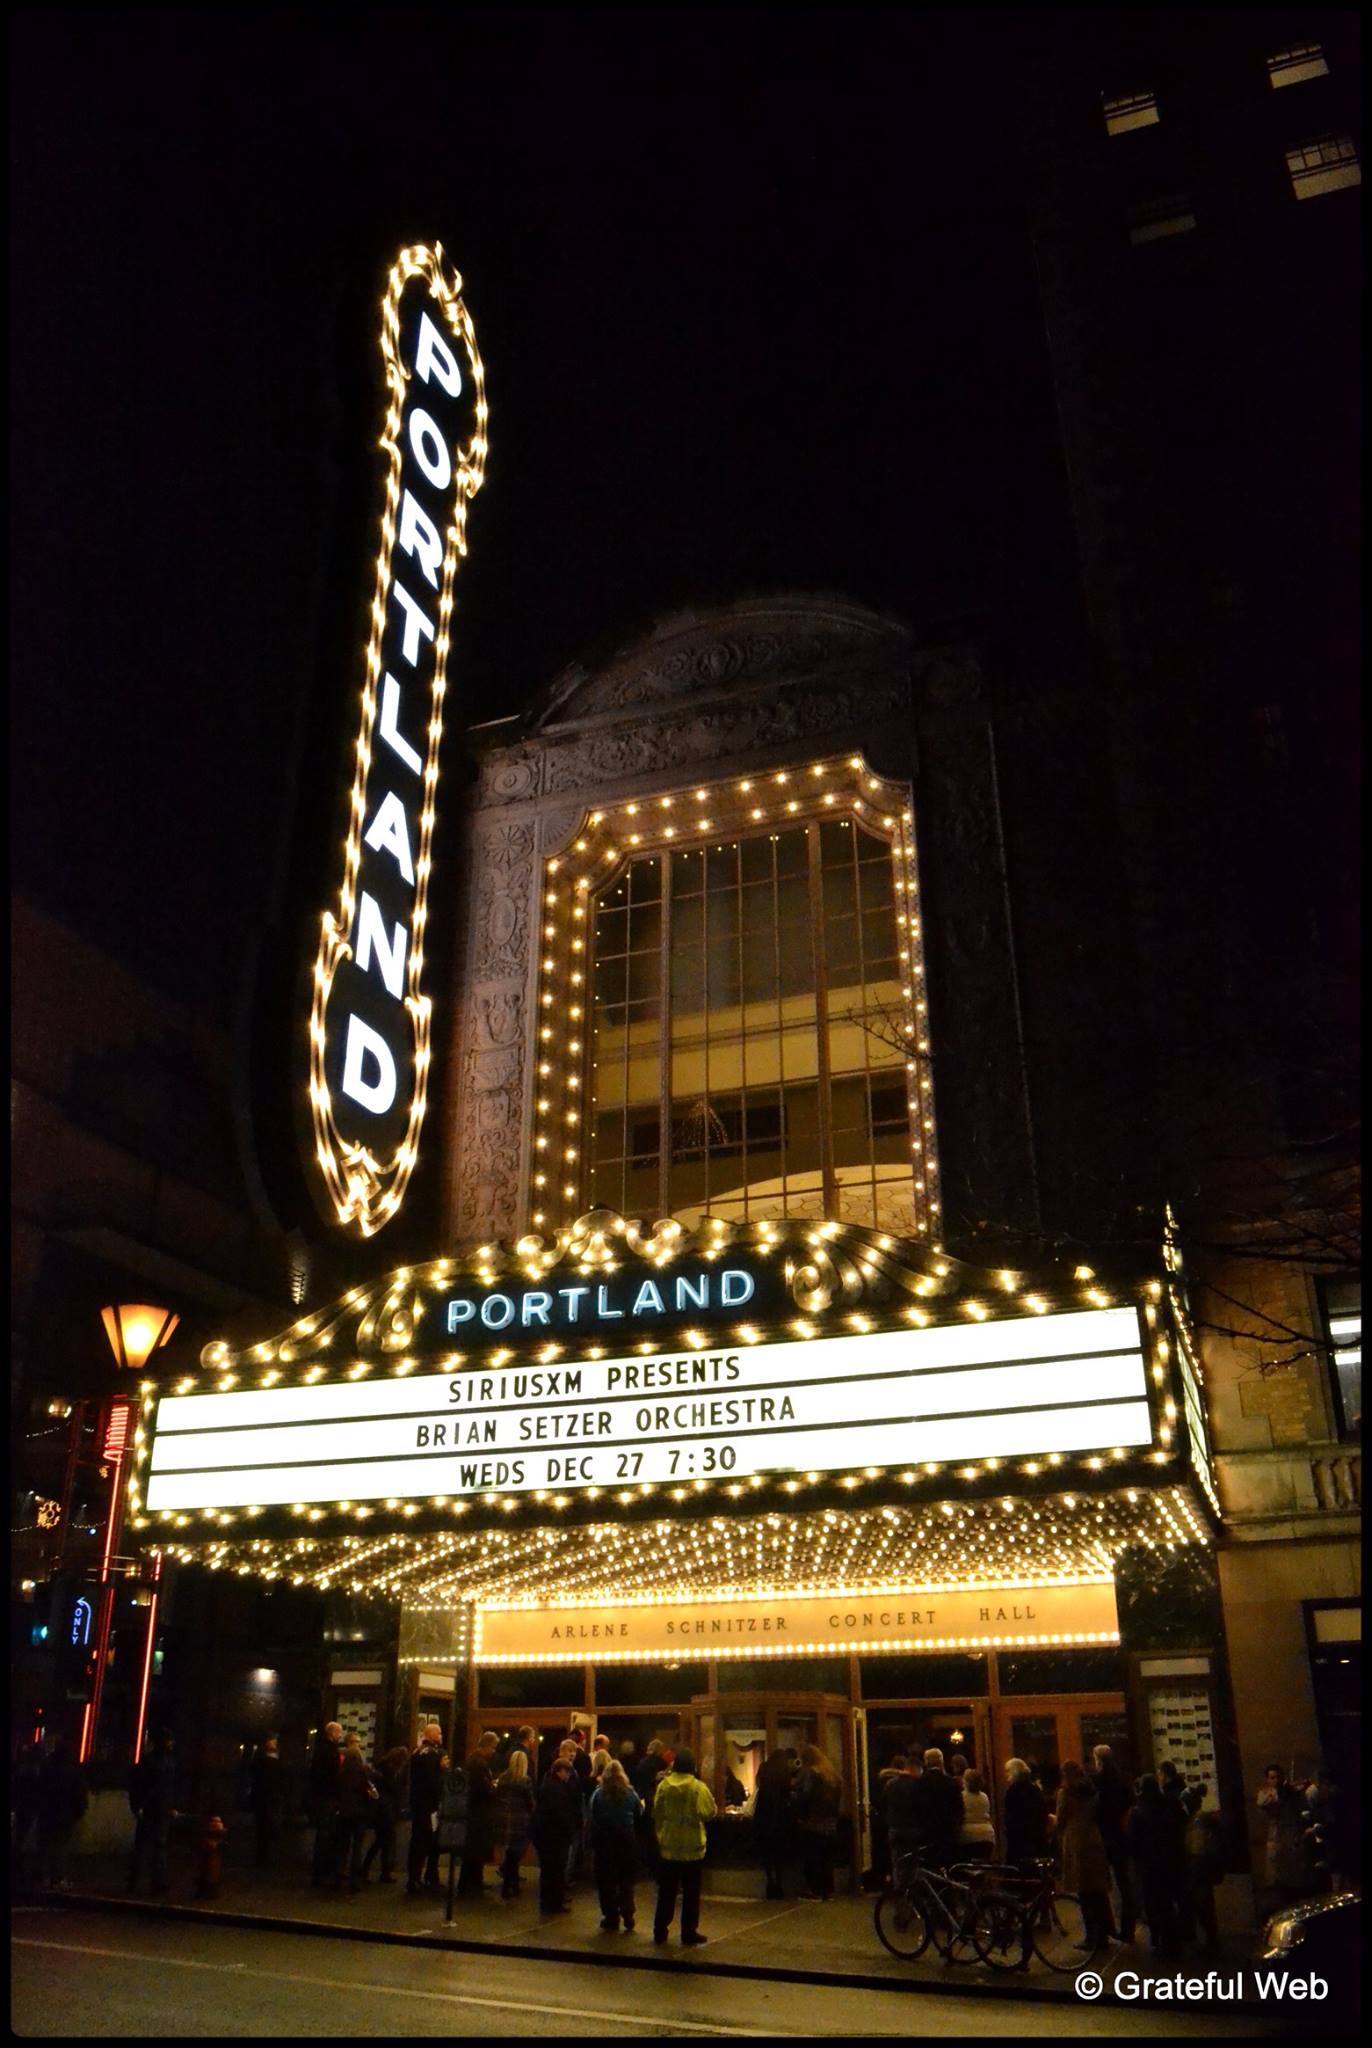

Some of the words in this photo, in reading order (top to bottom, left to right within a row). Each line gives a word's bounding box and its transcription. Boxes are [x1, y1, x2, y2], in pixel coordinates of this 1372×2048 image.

[343, 311, 462, 1114] PORTLAND
[447, 1270, 755, 1335] PORTLAND
[449, 1370, 582, 1403] SIRIUSXM
[607, 1356, 740, 1390] PRESENTS
[416, 1419, 497, 1447] BRIAN
[519, 1411, 613, 1441] SETZER
[636, 1395, 795, 1431] ORCHESTRA
[460, 1460, 526, 1488] WEDS
[547, 1456, 594, 1482] DEC
[616, 1452, 644, 1478] 27
[668, 1445, 737, 1474] 7:30
[72, 1608, 82, 1645] ONLY
[551, 1623, 630, 1639] ARLENE
[666, 1617, 788, 1635] SCHNITZER
[829, 1610, 937, 1629] CONCERT
[980, 1606, 1036, 1622] HALL
